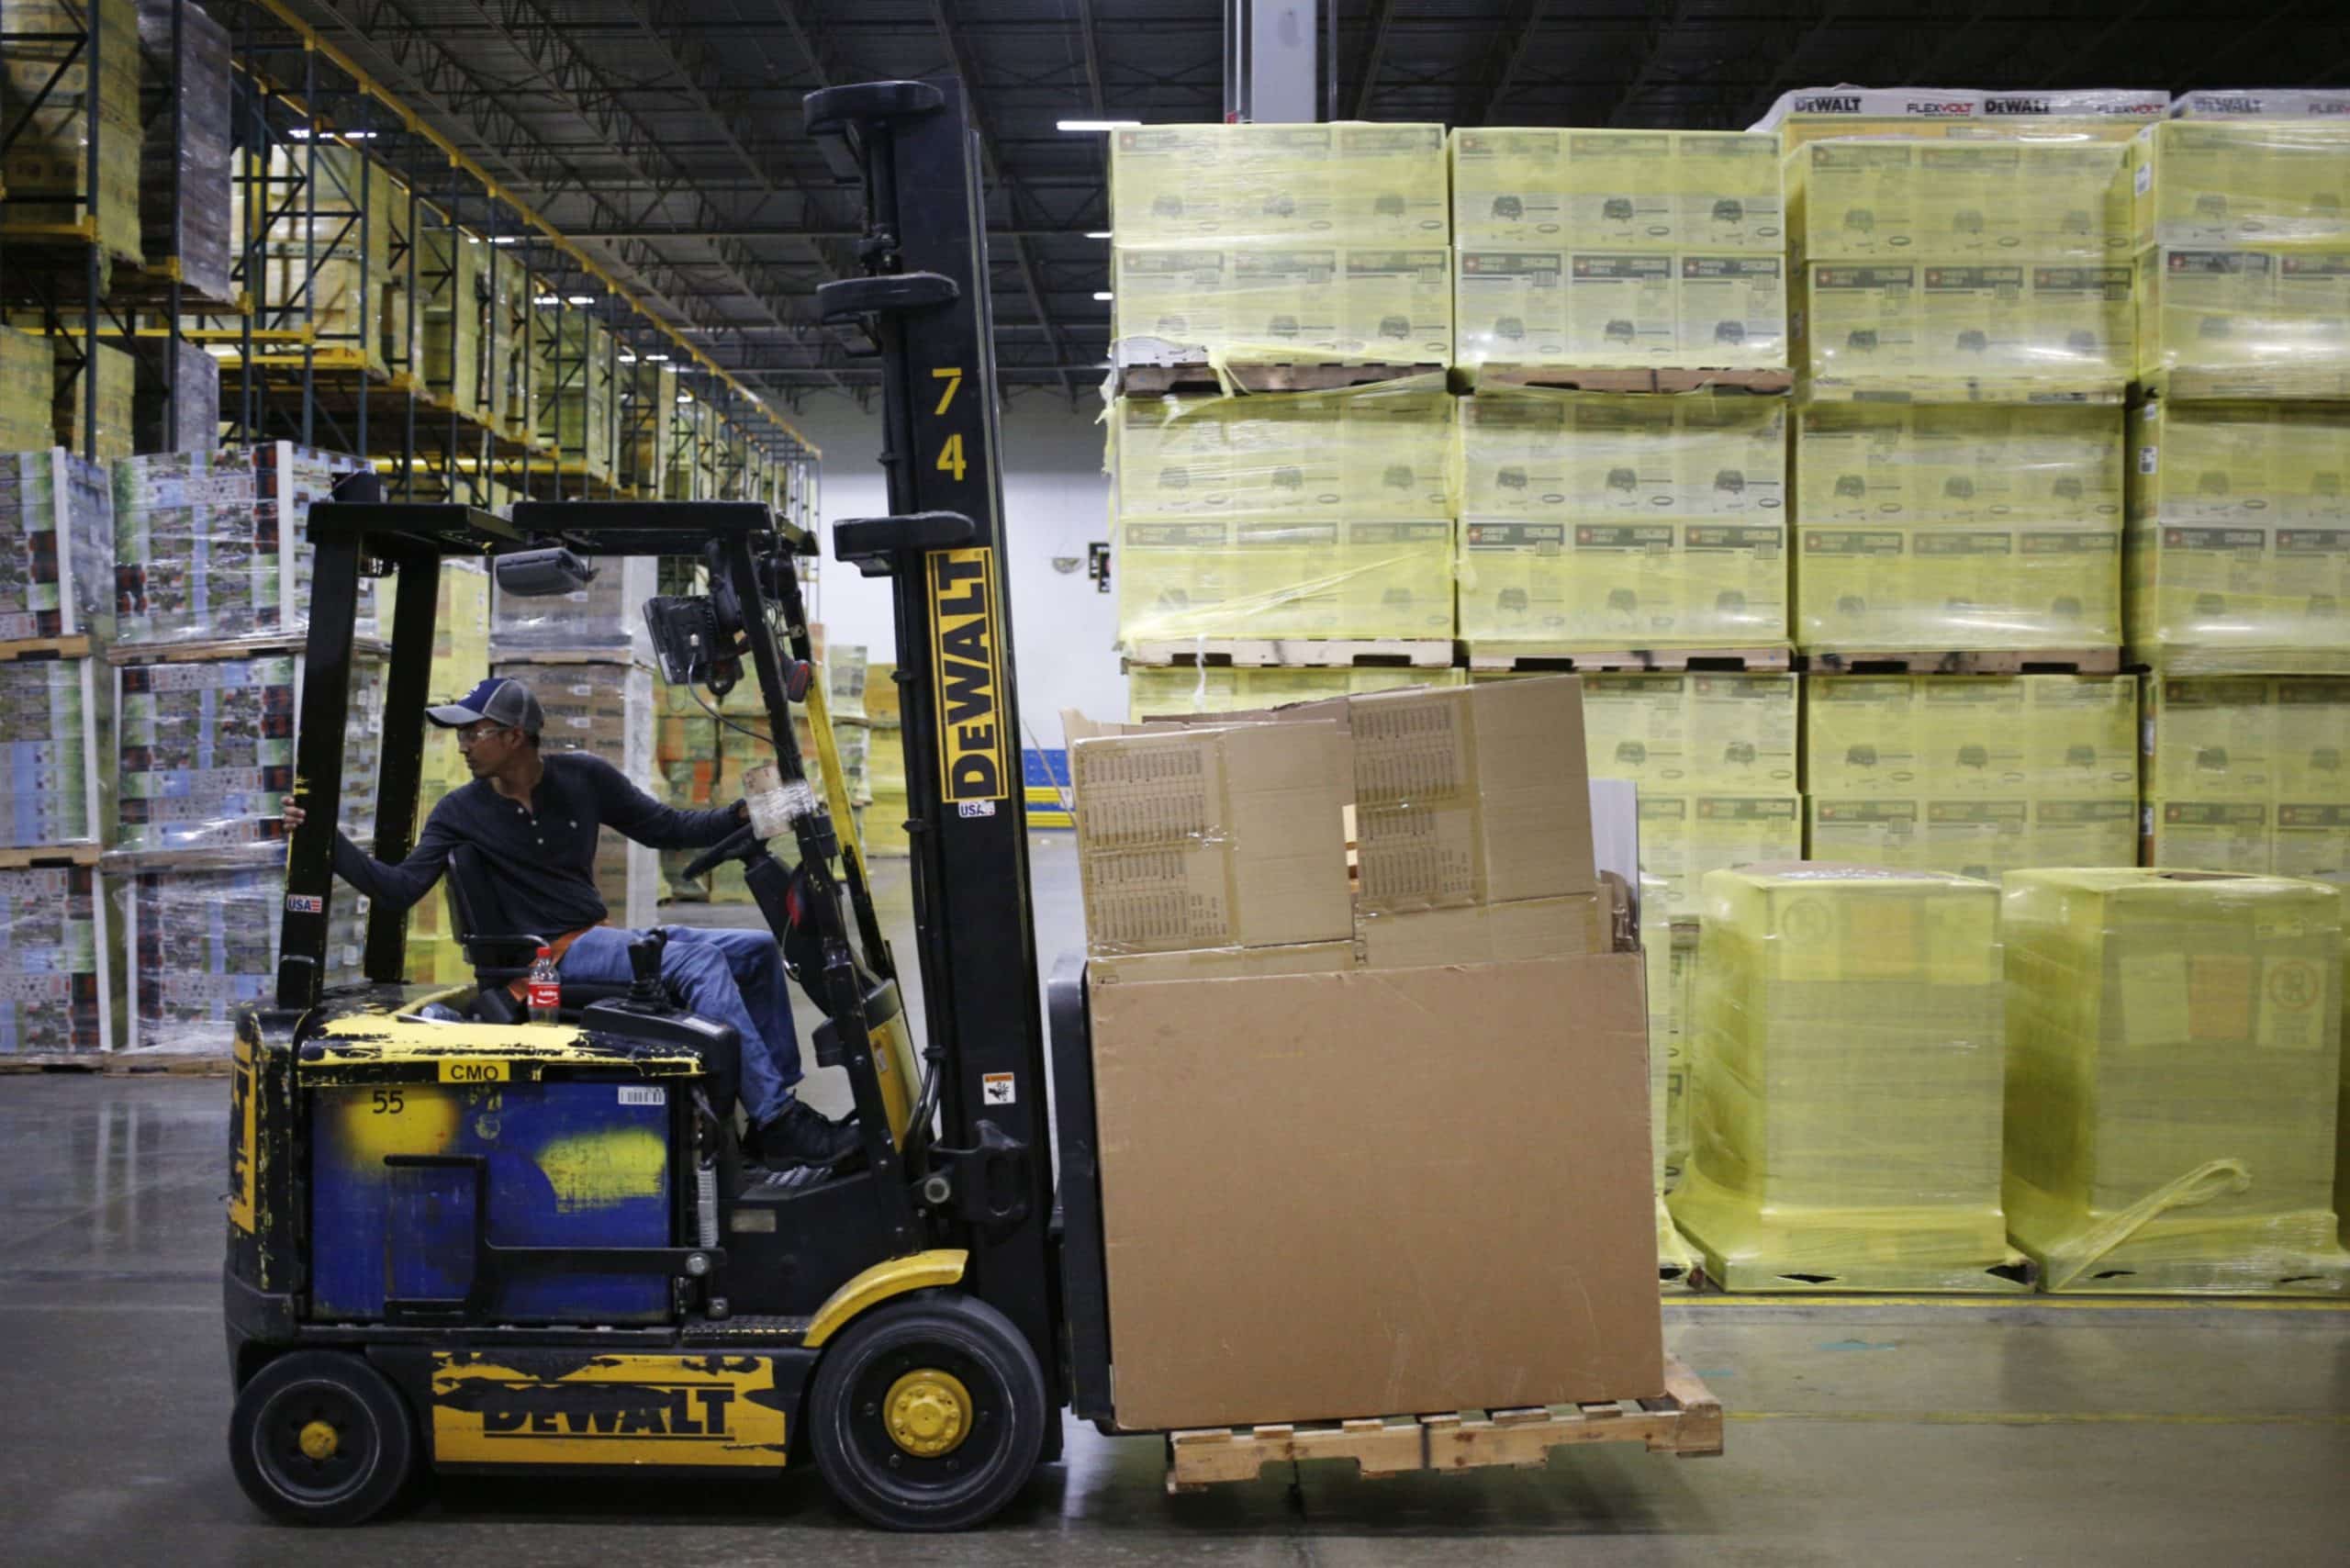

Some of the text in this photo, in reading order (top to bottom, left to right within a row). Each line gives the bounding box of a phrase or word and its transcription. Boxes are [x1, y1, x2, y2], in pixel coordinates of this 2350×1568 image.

[1907, 103, 1975, 113] FLEXVOLT
[936, 551, 999, 799] DEWALT
[960, 804, 985, 816] USA
[288, 900, 311, 911] USA
[450, 1065, 499, 1081] CMO
[373, 1090, 405, 1114] 55
